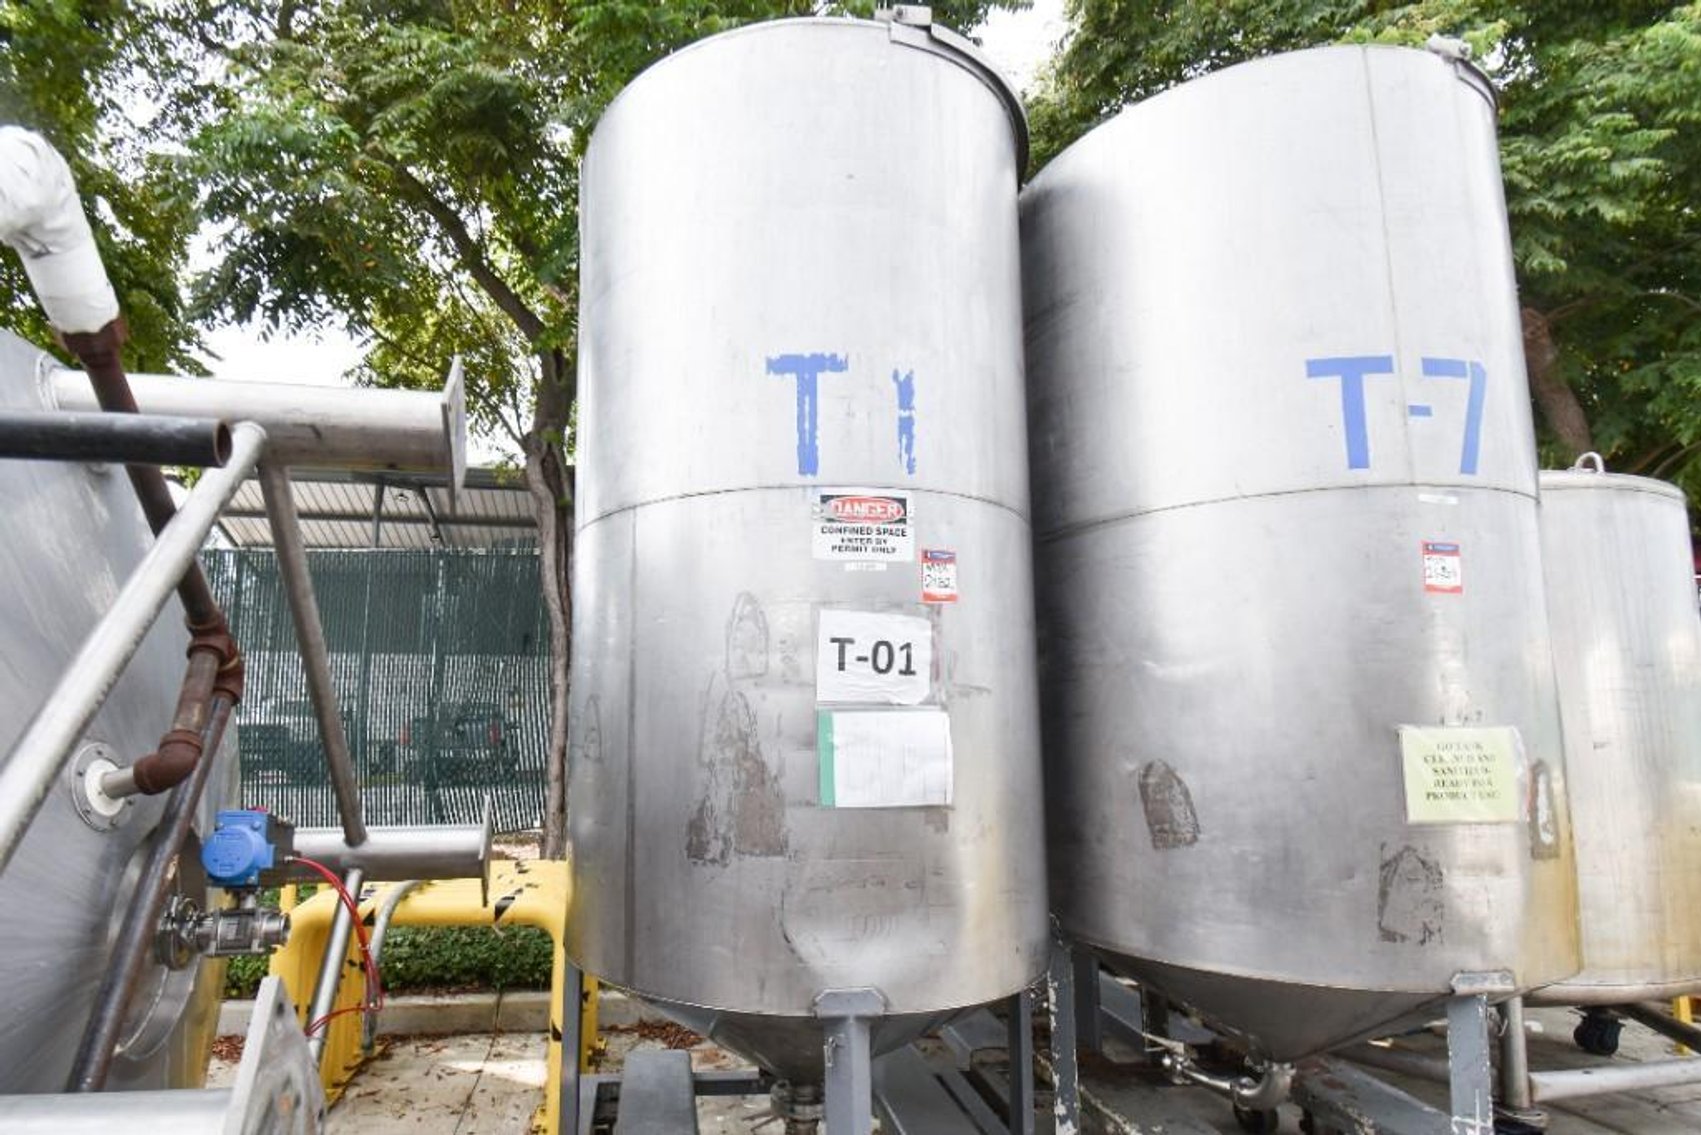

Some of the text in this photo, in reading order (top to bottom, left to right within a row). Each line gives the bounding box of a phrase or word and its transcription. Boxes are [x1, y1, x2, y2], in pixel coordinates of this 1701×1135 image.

[1306, 356, 1486, 475] T-7
[831, 501, 899, 519] DANGER
[820, 526, 908, 537] CONFINED SPACE
[831, 546, 897, 554] PERMIT ONLY
[830, 637, 917, 677] T-01
